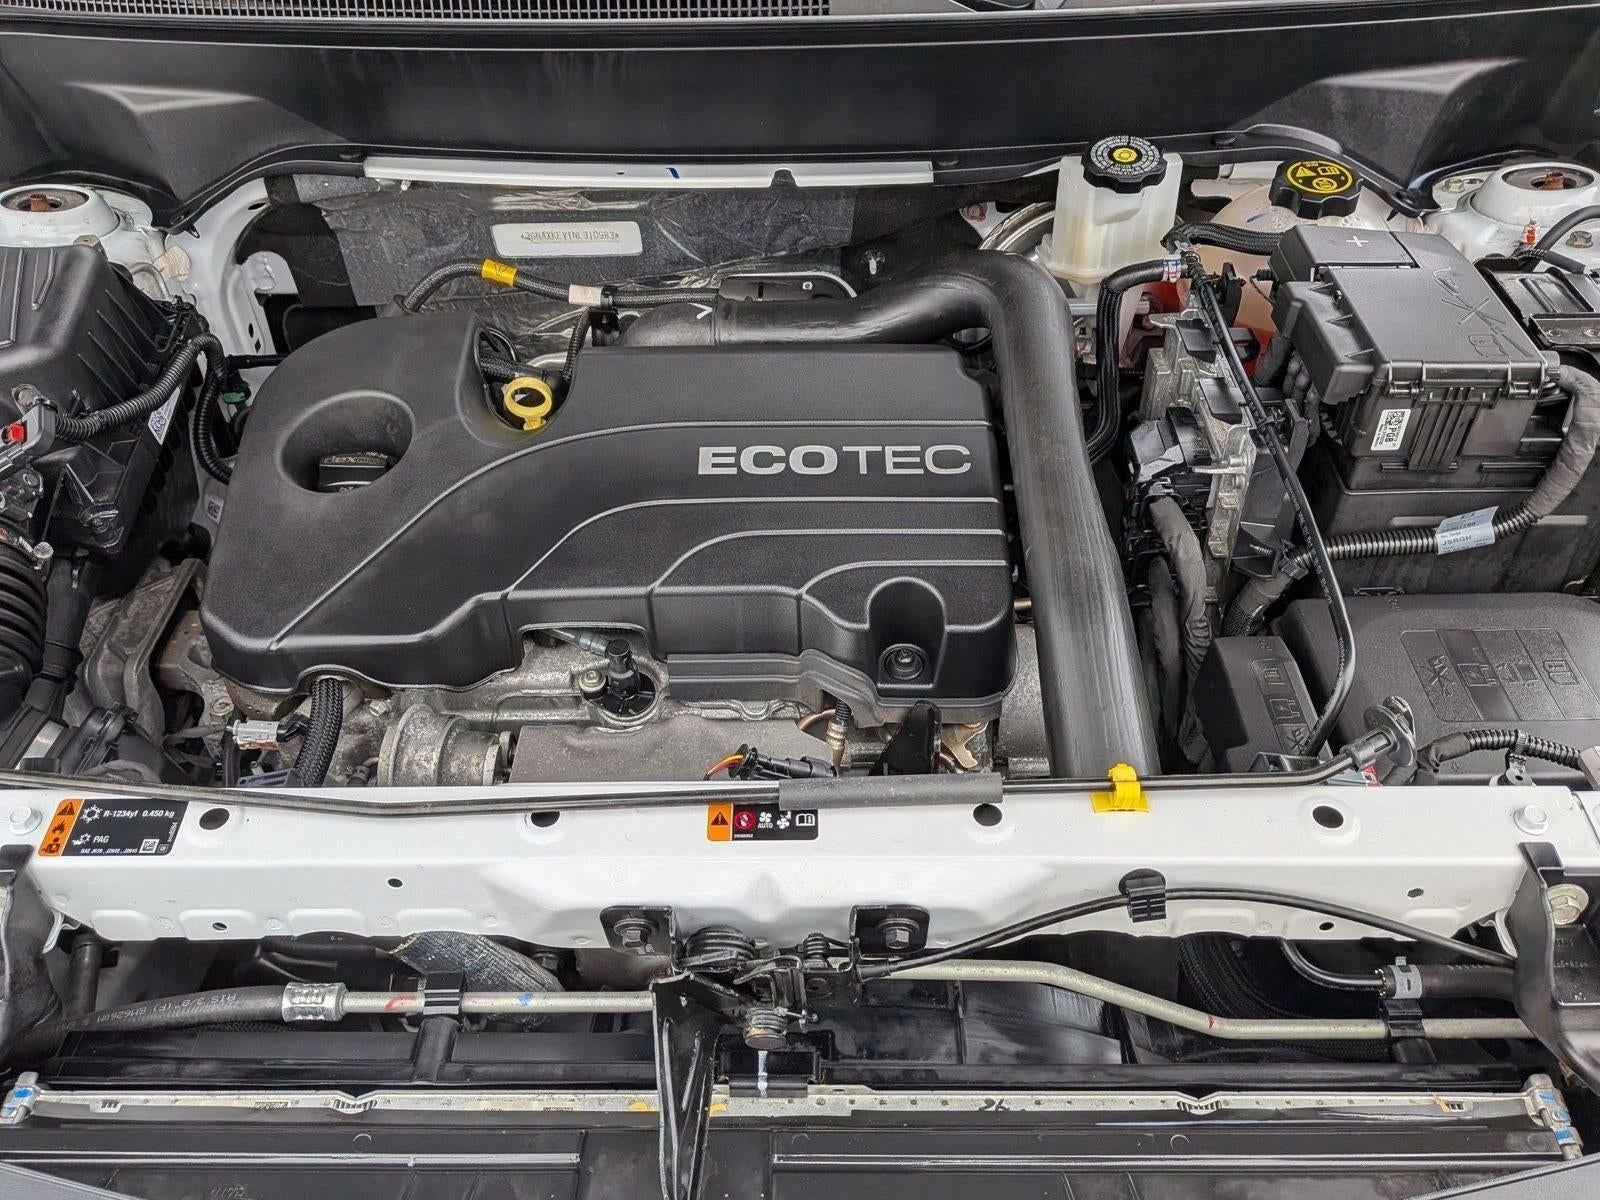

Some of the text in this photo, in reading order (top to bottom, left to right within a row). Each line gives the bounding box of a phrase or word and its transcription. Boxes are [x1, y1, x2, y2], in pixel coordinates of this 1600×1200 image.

[698, 444, 972, 475] ECOTEC
[103, 810, 139, 820] R-1234yf
[164, 810, 175, 819] kg
[92, 835, 110, 844] PAG
